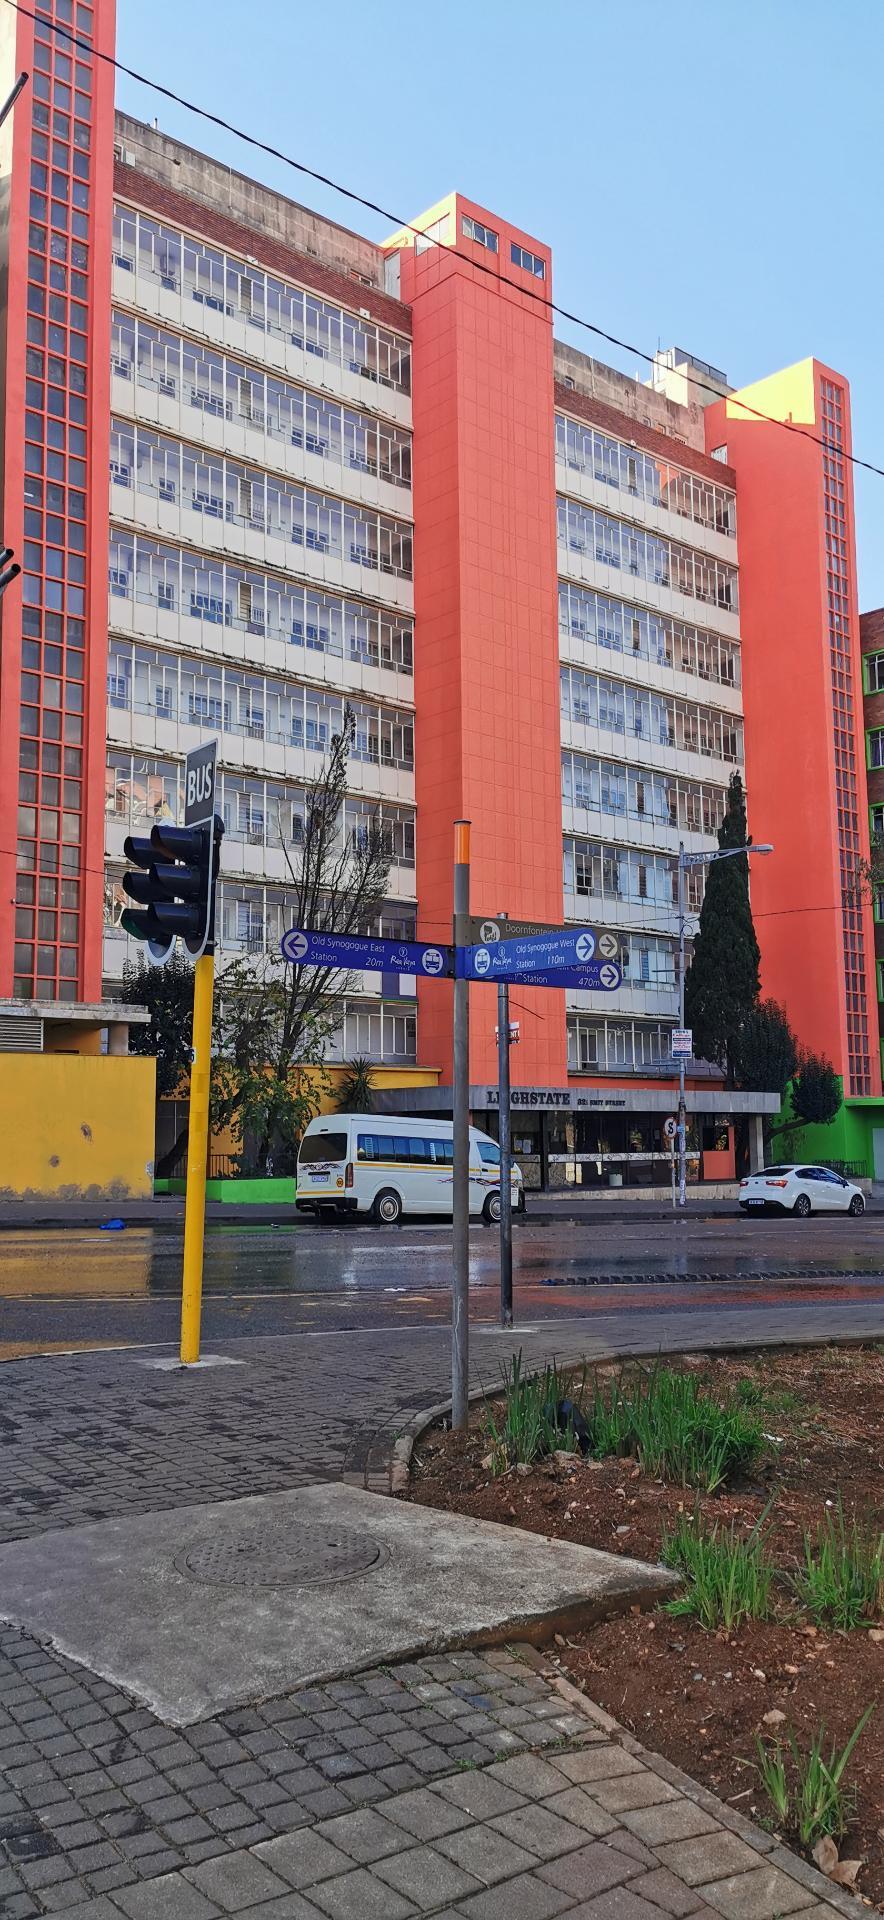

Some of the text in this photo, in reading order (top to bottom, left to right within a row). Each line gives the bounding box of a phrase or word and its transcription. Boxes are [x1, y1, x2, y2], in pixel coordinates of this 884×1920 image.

[187, 762, 212, 806] BUS
[505, 923, 554, 935] Doornfontein
[312, 936, 326, 945] Old
[370, 943, 385, 953] East
[516, 945, 527, 954] Old
[560, 939, 575, 948] West
[311, 951, 337, 961] Station
[548, 955, 565, 965] 110m
[365, 957, 384, 967] 20m
[516, 959, 536, 969] Station
[523, 973, 548, 984] Station
[579, 978, 600, 986] 470m
[487, 1091, 570, 1105] LGHSTATE
